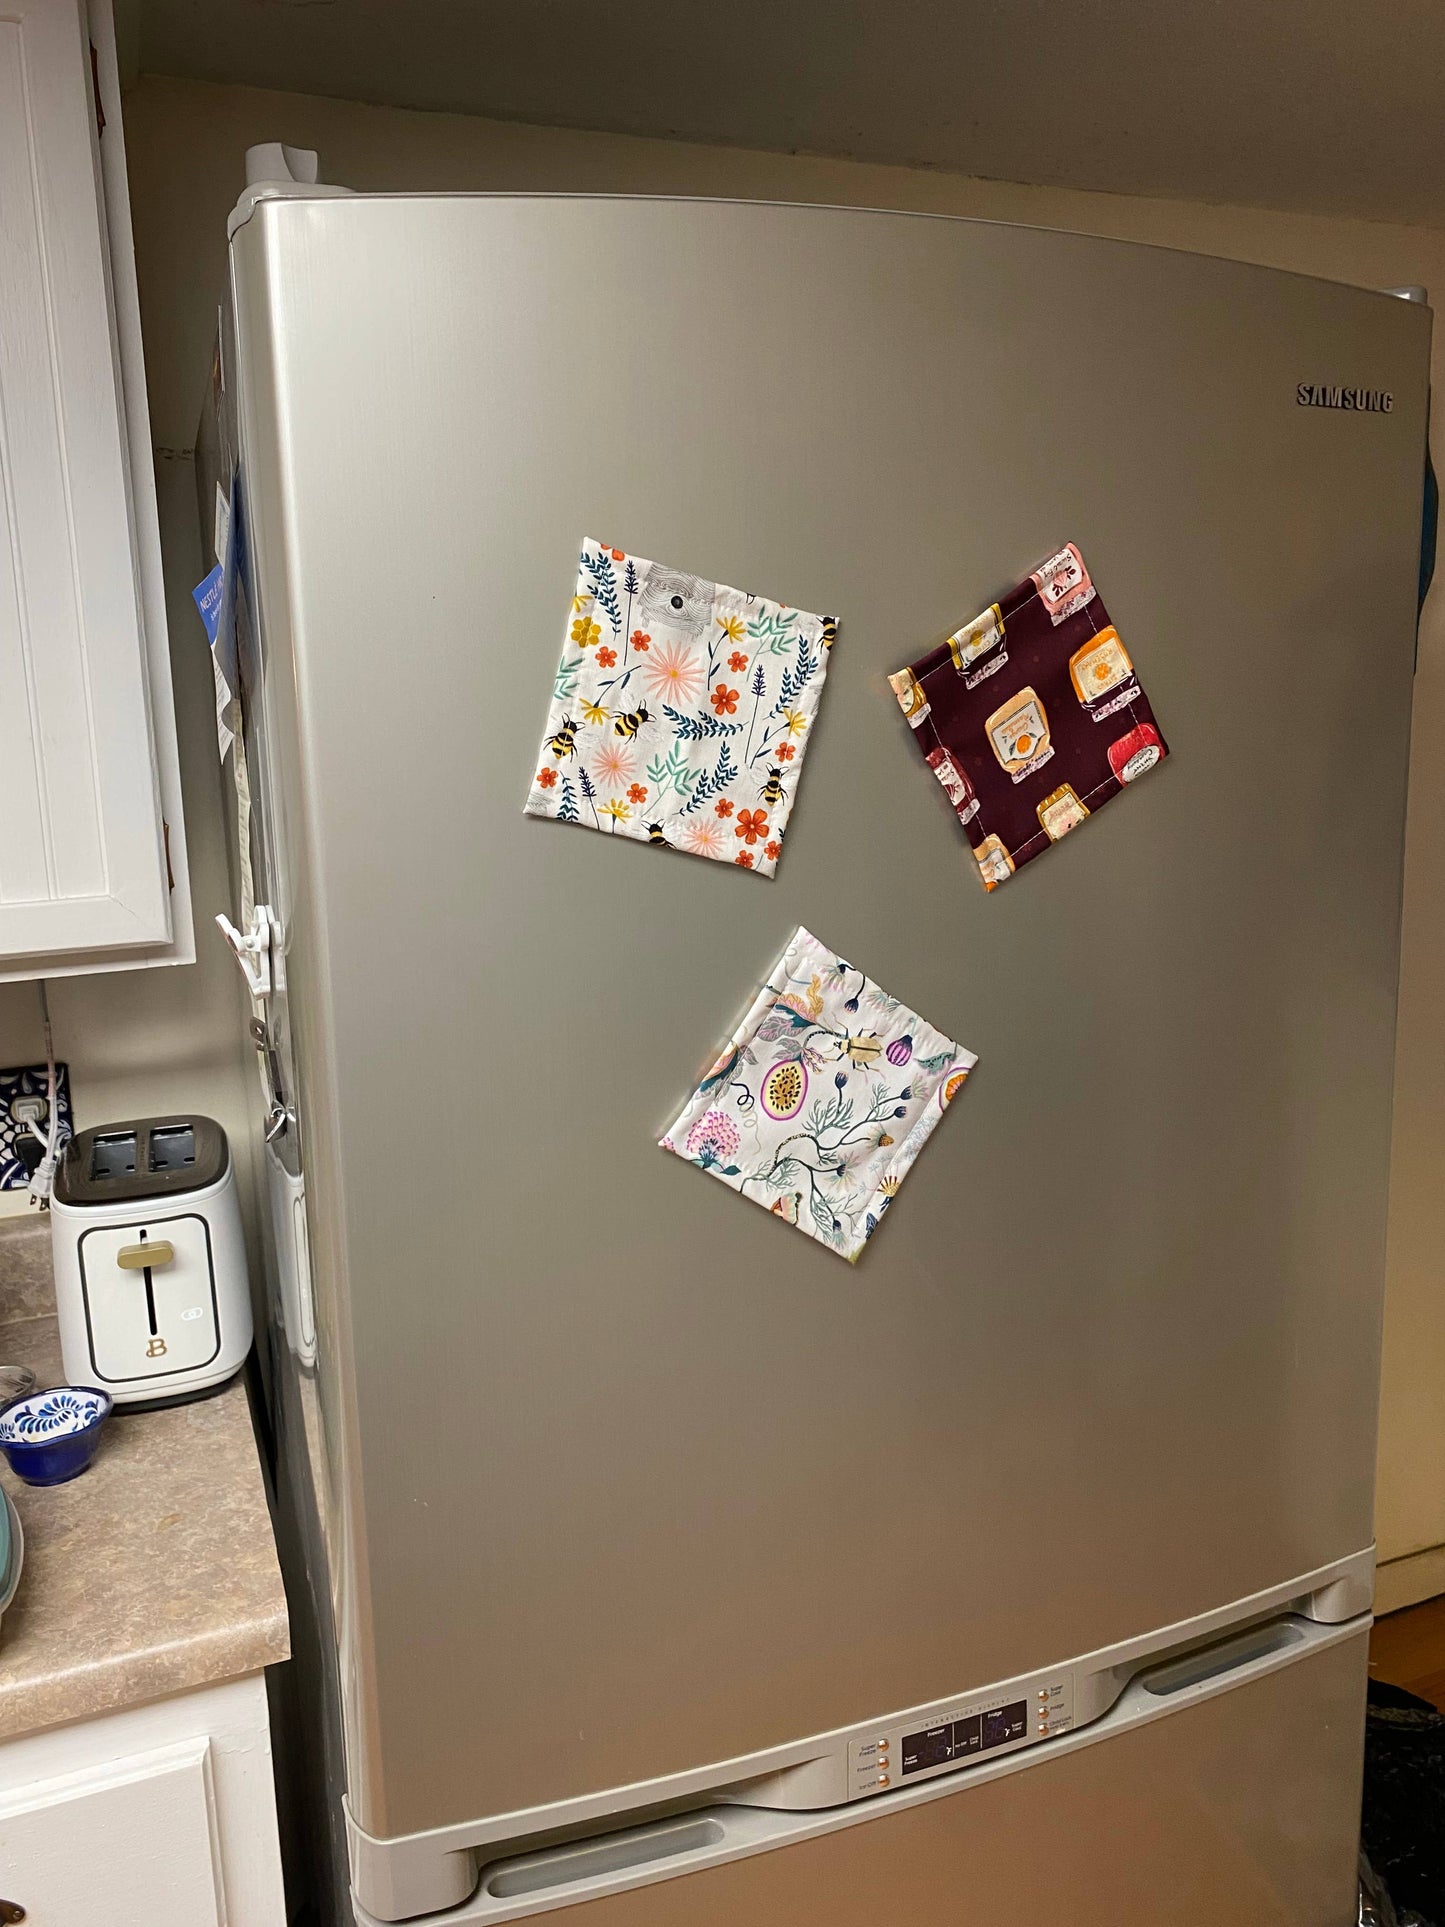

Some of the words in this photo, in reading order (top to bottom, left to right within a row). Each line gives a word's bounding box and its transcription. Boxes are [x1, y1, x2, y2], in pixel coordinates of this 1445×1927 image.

[1297, 382, 1393, 413] SAMSUNG
[146, 1338, 168, 1358] B
[987, 1710, 1003, 1719] Fridge
[927, 1728, 945, 1737] Freezer
